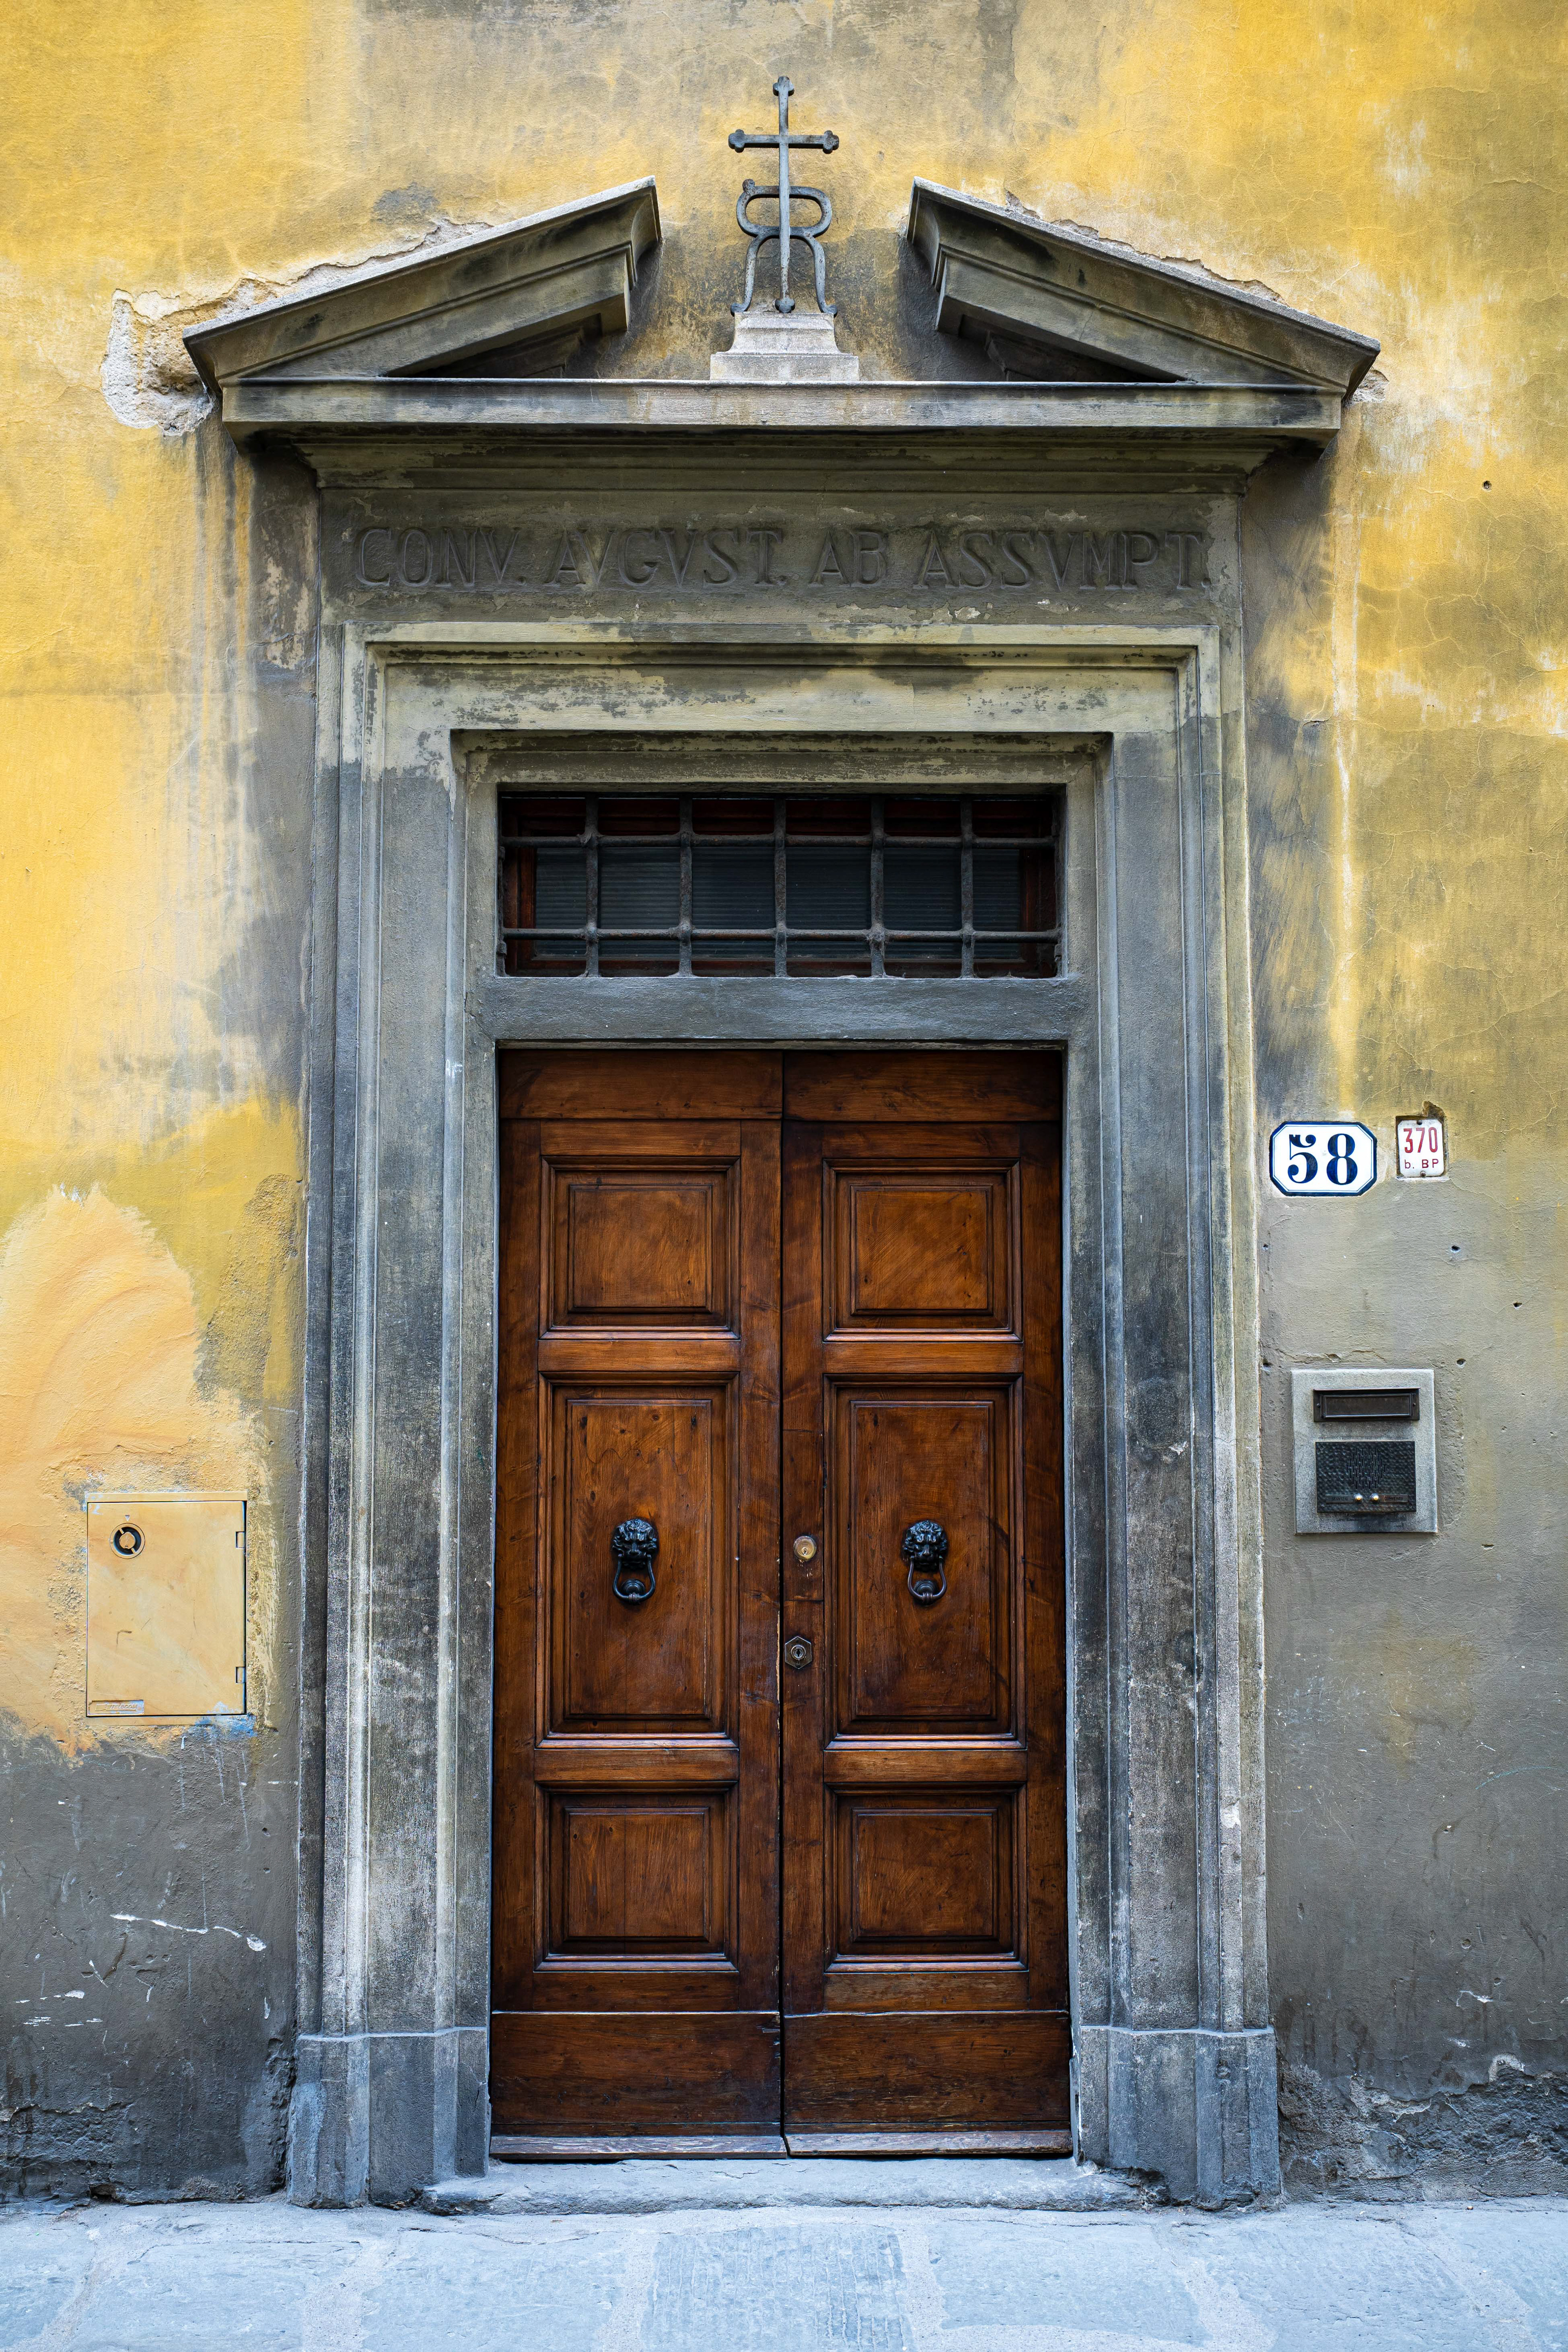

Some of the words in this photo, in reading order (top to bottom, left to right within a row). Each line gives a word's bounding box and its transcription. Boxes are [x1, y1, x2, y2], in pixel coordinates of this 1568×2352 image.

[808, 528, 888, 587] AB
[1287, 1133, 1358, 1185] 58
[1403, 1127, 1439, 1154] 370
